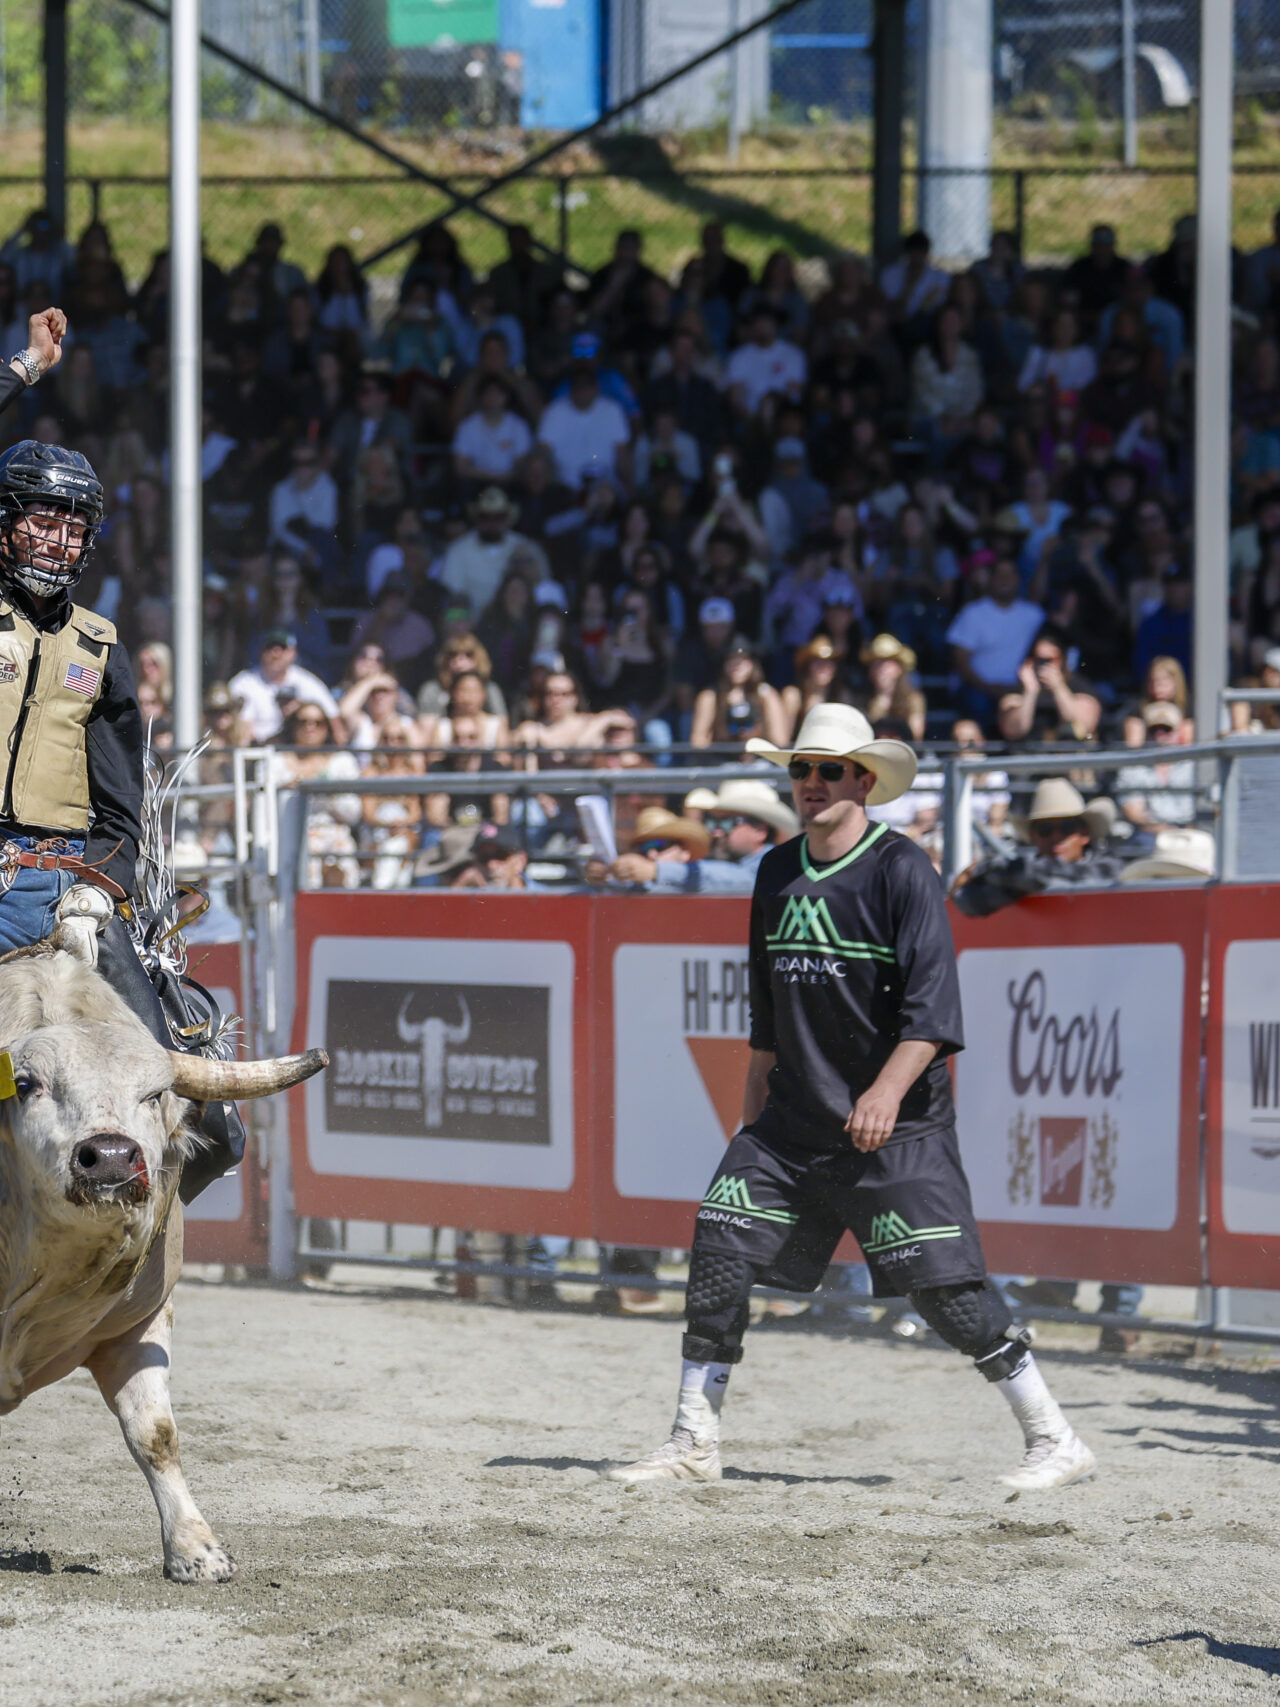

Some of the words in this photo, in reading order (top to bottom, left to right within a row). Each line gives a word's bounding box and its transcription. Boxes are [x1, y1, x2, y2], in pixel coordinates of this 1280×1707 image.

[56, 473, 89, 487] BAUER
[774, 956, 848, 978] ADANAC
[1007, 969, 1123, 1098] Coors
[697, 1209, 752, 1229] ADANAC
